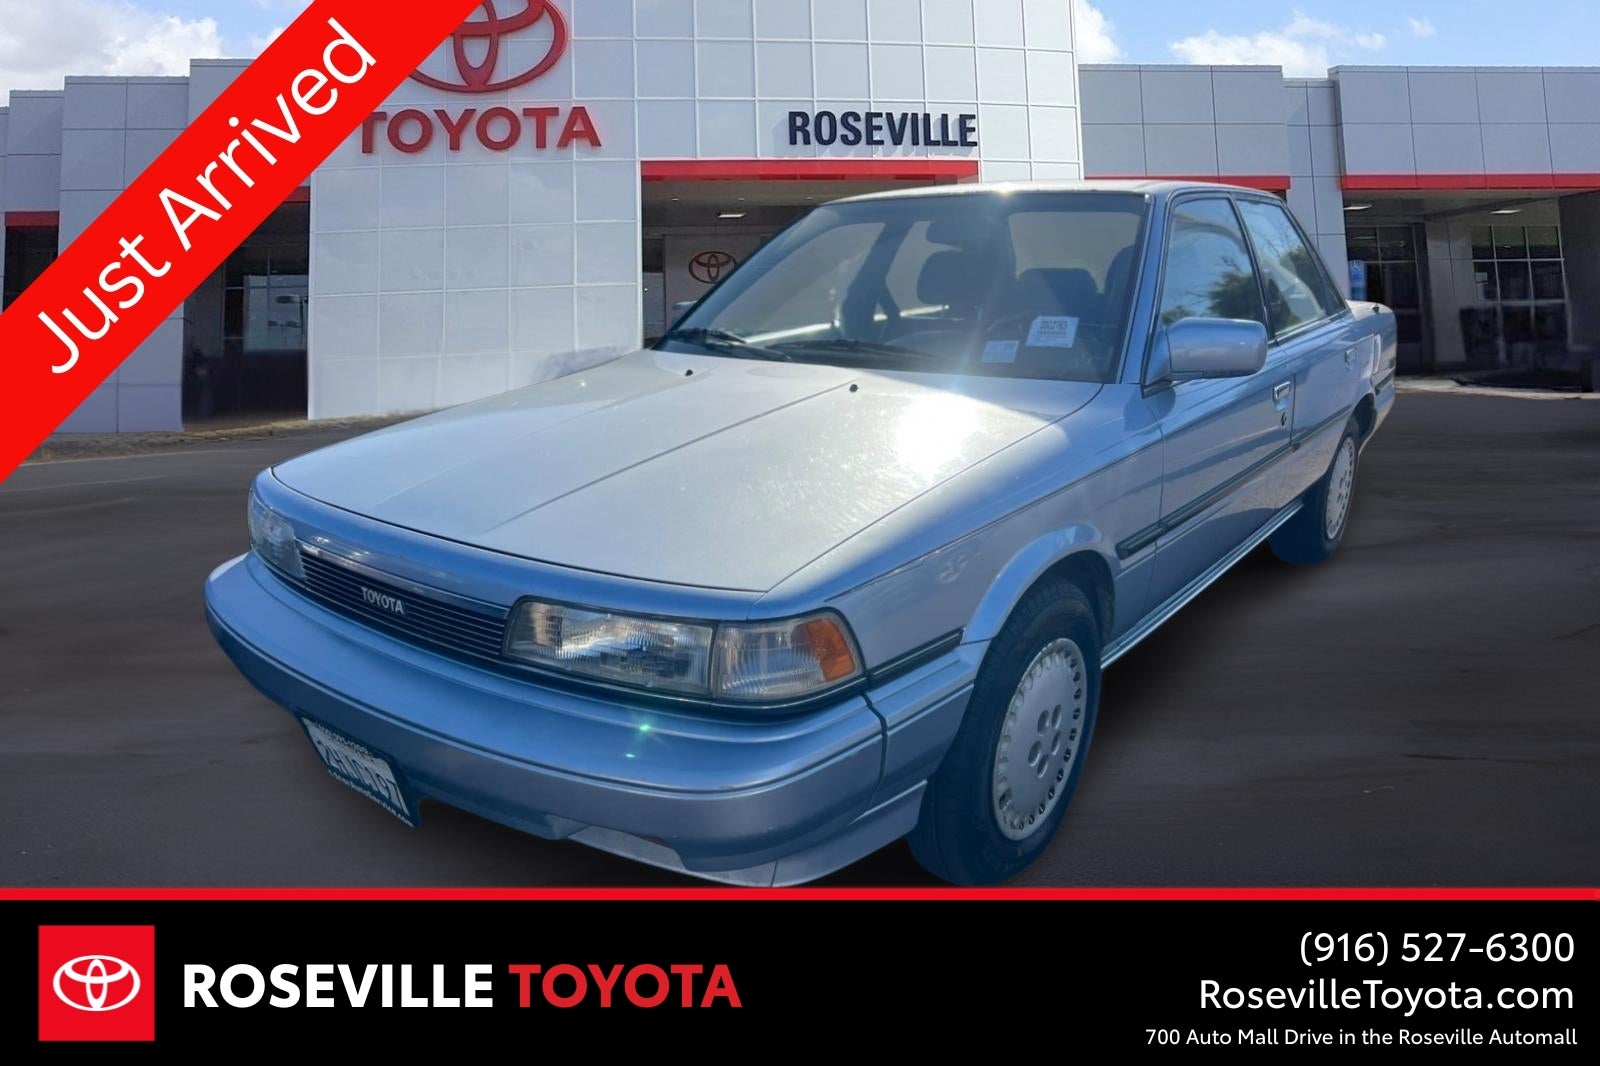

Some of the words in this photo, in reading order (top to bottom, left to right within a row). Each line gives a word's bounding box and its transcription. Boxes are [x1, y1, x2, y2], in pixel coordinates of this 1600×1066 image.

[361, 106, 602, 154] TOYOTA
[788, 110, 978, 146] ROSEVILLE
[361, 586, 405, 615] TOYOTA
